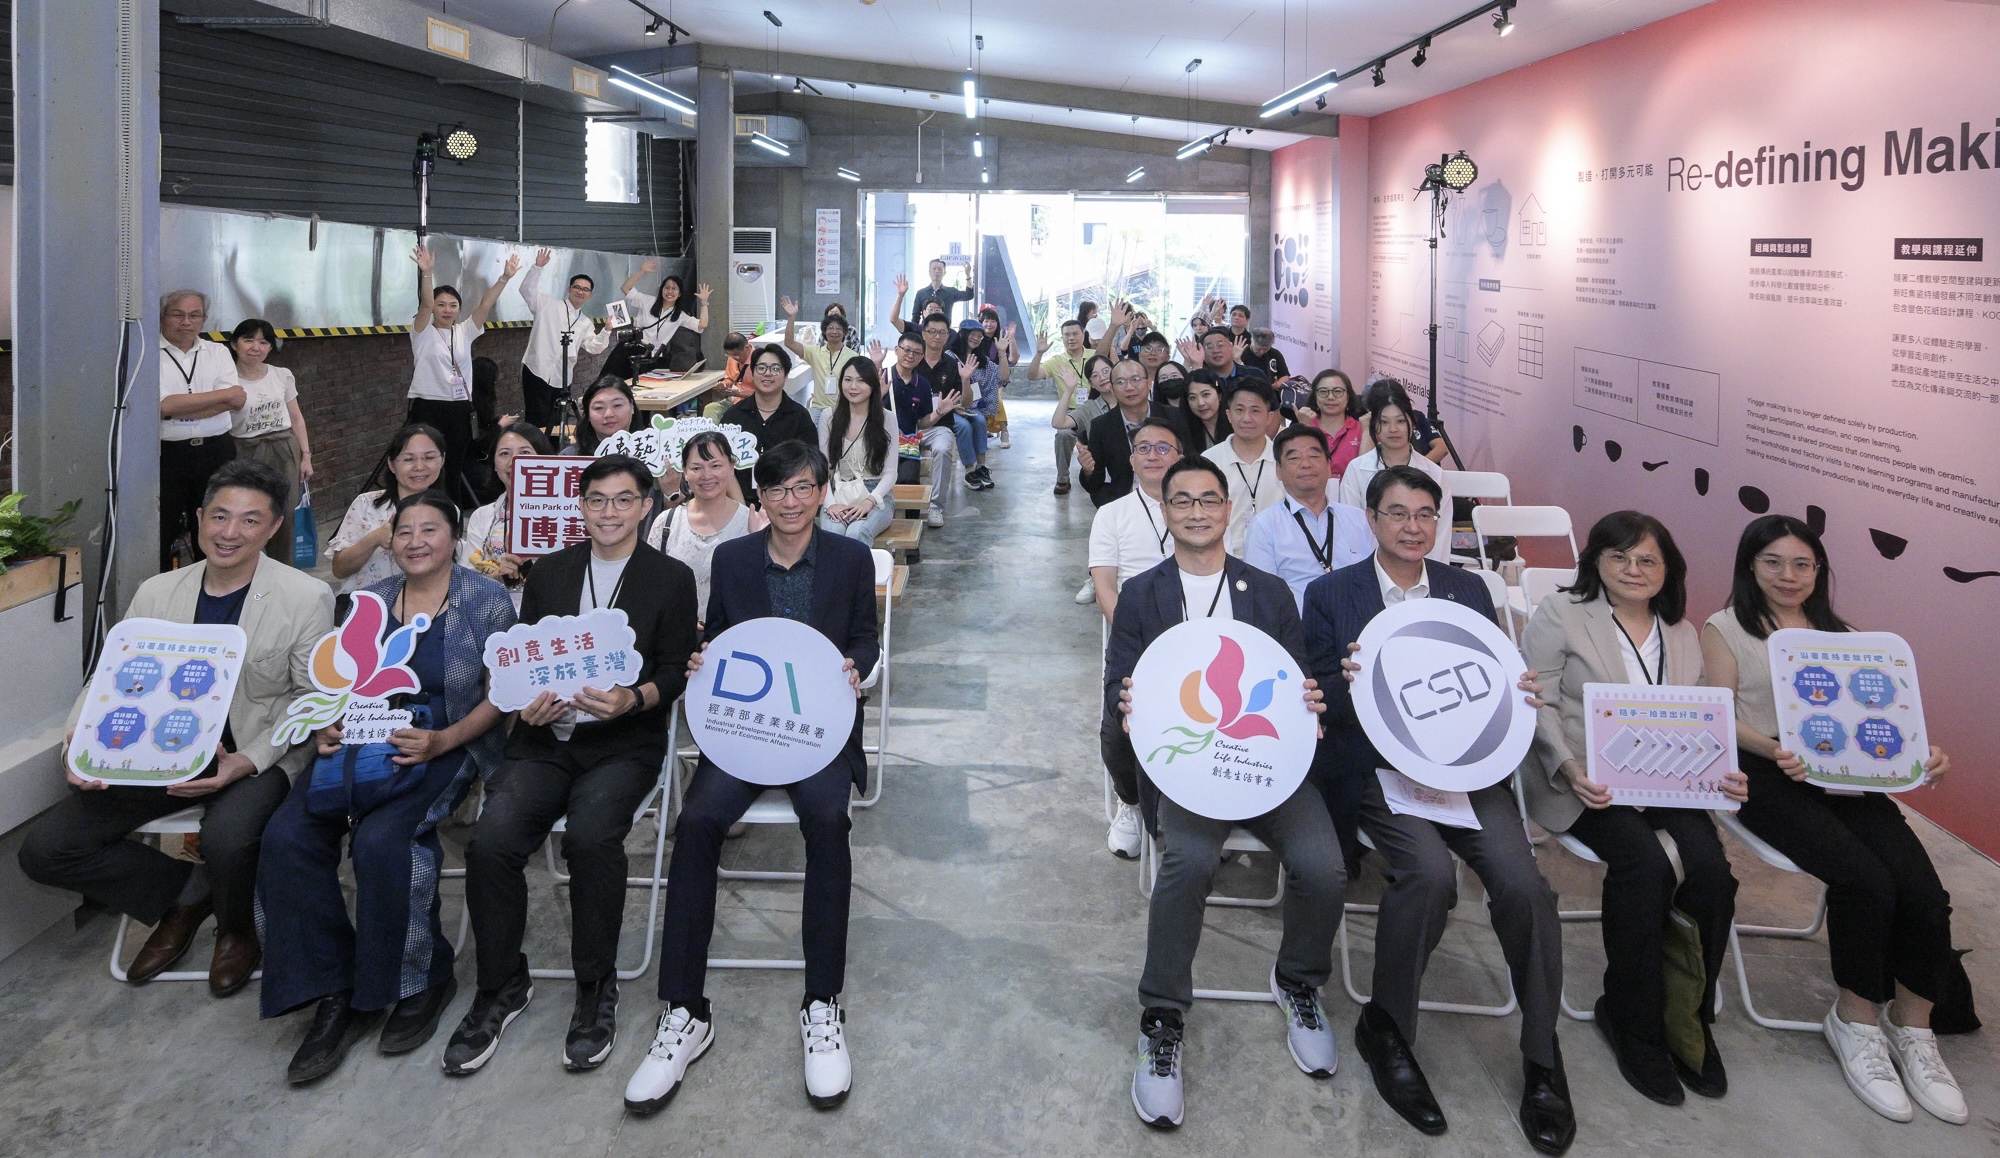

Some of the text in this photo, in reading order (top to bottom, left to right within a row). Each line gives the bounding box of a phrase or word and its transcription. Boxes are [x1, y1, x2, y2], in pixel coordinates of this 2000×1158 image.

[1667, 117, 2000, 192] Re-defining Maki
[1578, 163, 1654, 183] 製造，打開多元可能
[1900, 243, 1978, 257] 教學與課程延伸
[1892, 333, 1989, 352] 讓更多人從體驗走向學習，
[1892, 349, 1953, 363] 從學習走向創作，
[1402, 377, 1430, 399] Materials
[250, 401, 281, 413] LIMITED
[719, 424, 742, 434] Living
[1747, 398, 1764, 407] Yingge
[1766, 401, 1785, 411] making
[1803, 408, 1820, 419] longer
[1823, 413, 1846, 423] defined
[1848, 418, 1866, 429] solely
[1868, 423, 1876, 432] by
[1878, 425, 1918, 439] production.
[1747, 410, 1768, 422] Through
[1769, 416, 1805, 428] participation,
[1807, 424, 1838, 436] education,
[1854, 436, 1870, 445] open
[1872, 438, 1901, 452] learning,
[1746, 424, 1765, 434] making
[1766, 427, 1791, 438] becomes
[1798, 436, 1817, 445] shared
[1819, 441, 1843, 452] process
[1845, 447, 1857, 456] that
[1860, 451, 1890, 463] connects
[1892, 458, 1917, 470] people
[1919, 465, 1935, 474] with
[1938, 470, 1976, 485] ceramics.
[1746, 436, 1759, 444] From
[1761, 439, 1789, 452] workshops
[1803, 450, 1824, 462] factory
[1826, 456, 1842, 466] visits
[1852, 464, 1865, 472] new
[1868, 467, 1895, 480] learning
[1897, 476, 1932, 490] programs
[1935, 484, 1950, 494] and
[1952, 490, 2000, 508] manufactur
[1746, 449, 2000, 528] making extends beyond the production site into everyday life and creative ex
[542, 503, 562, 511] Park
[495, 632, 595, 667] 創意生活
[529, 649, 627, 686] 深旅臺灣
[1400, 661, 1491, 720] CSD
[349, 702, 384, 710] Creative
[347, 713, 407, 724] Life Industries
[707, 702, 826, 740] 經濟部產業發展署
[345, 728, 402, 739] 創意生活
[704, 725, 730, 736] Ministry
[738, 731, 769, 743] Economic
[769, 738, 790, 748] Affairs
[706, 717, 822, 749] Industrial Development Administration
[1214, 739, 1249, 753] Creative
[1213, 752, 1273, 770] Life Industries
[1211, 766, 1275, 788] 創意生活事業
